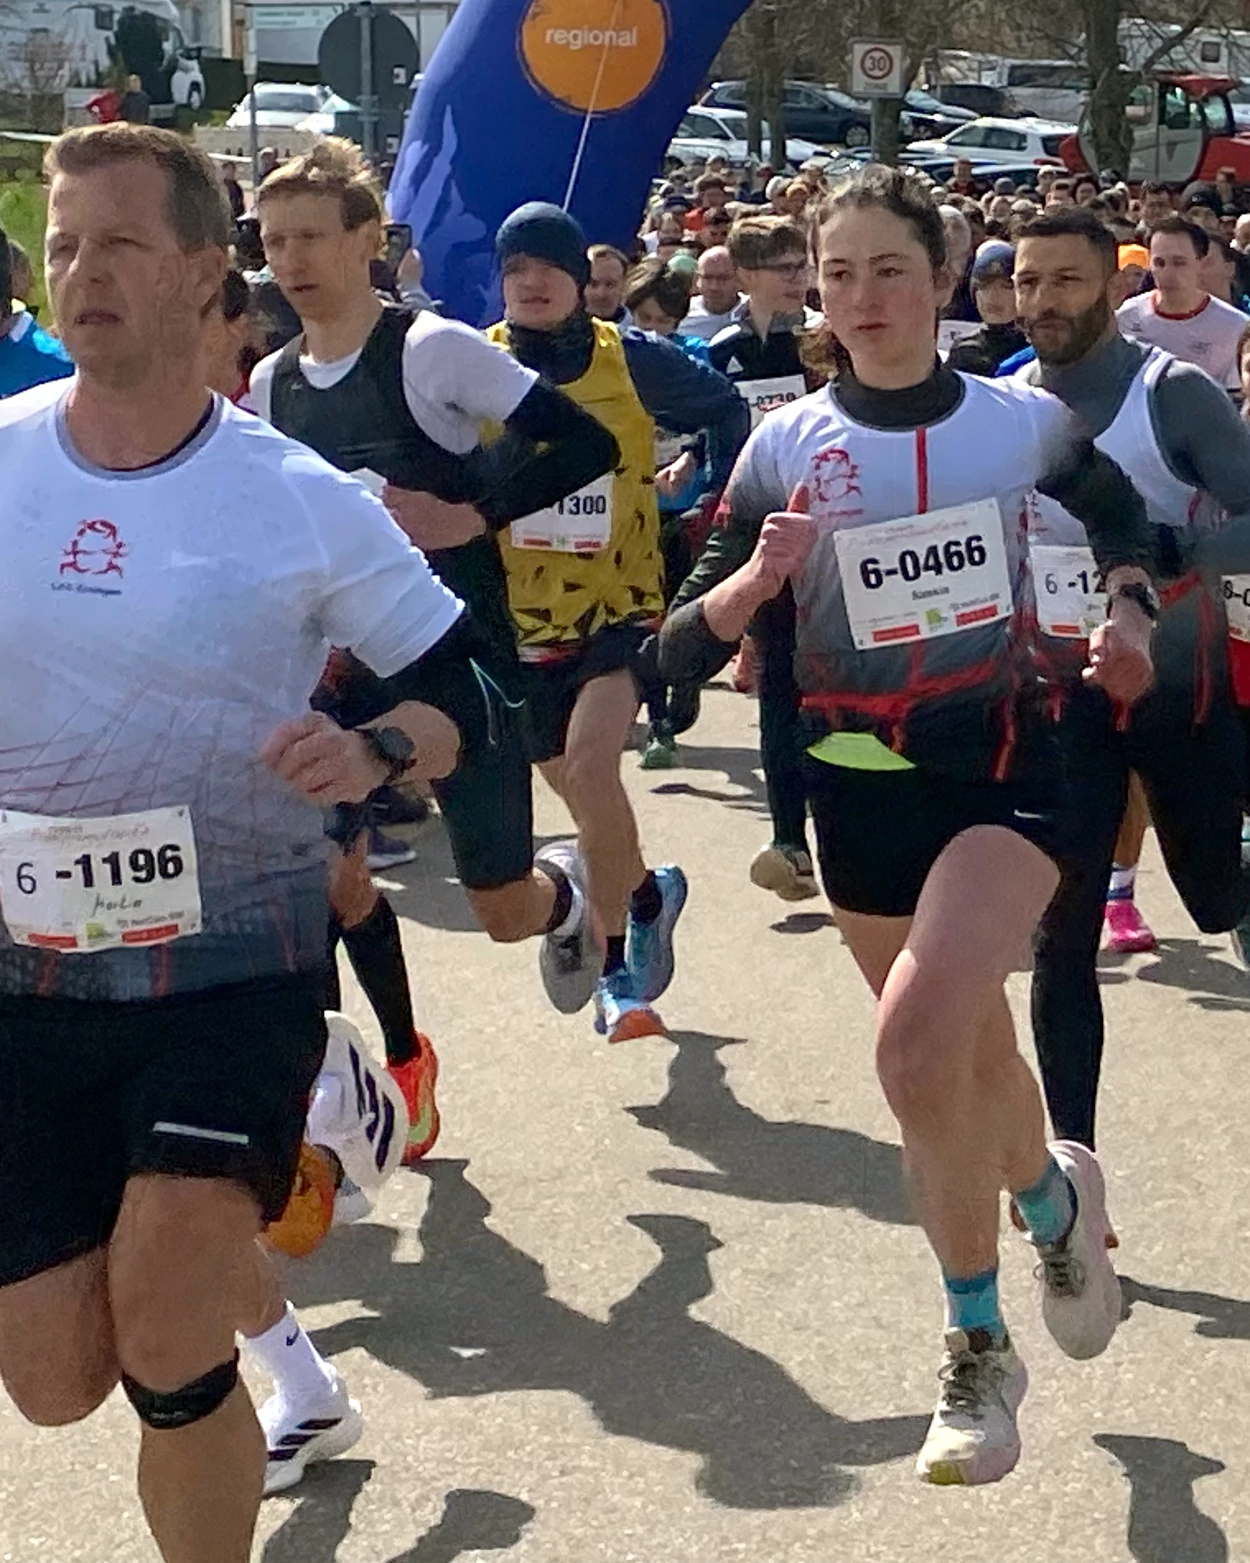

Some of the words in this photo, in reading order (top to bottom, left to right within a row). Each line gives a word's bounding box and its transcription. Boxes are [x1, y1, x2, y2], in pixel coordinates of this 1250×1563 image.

[545, 25, 638, 51] regional
[867, 55, 887, 72] 30
[859, 534, 987, 590] 6-0466
[16, 862, 37, 895] 6
[55, 843, 184, 889] -1196
